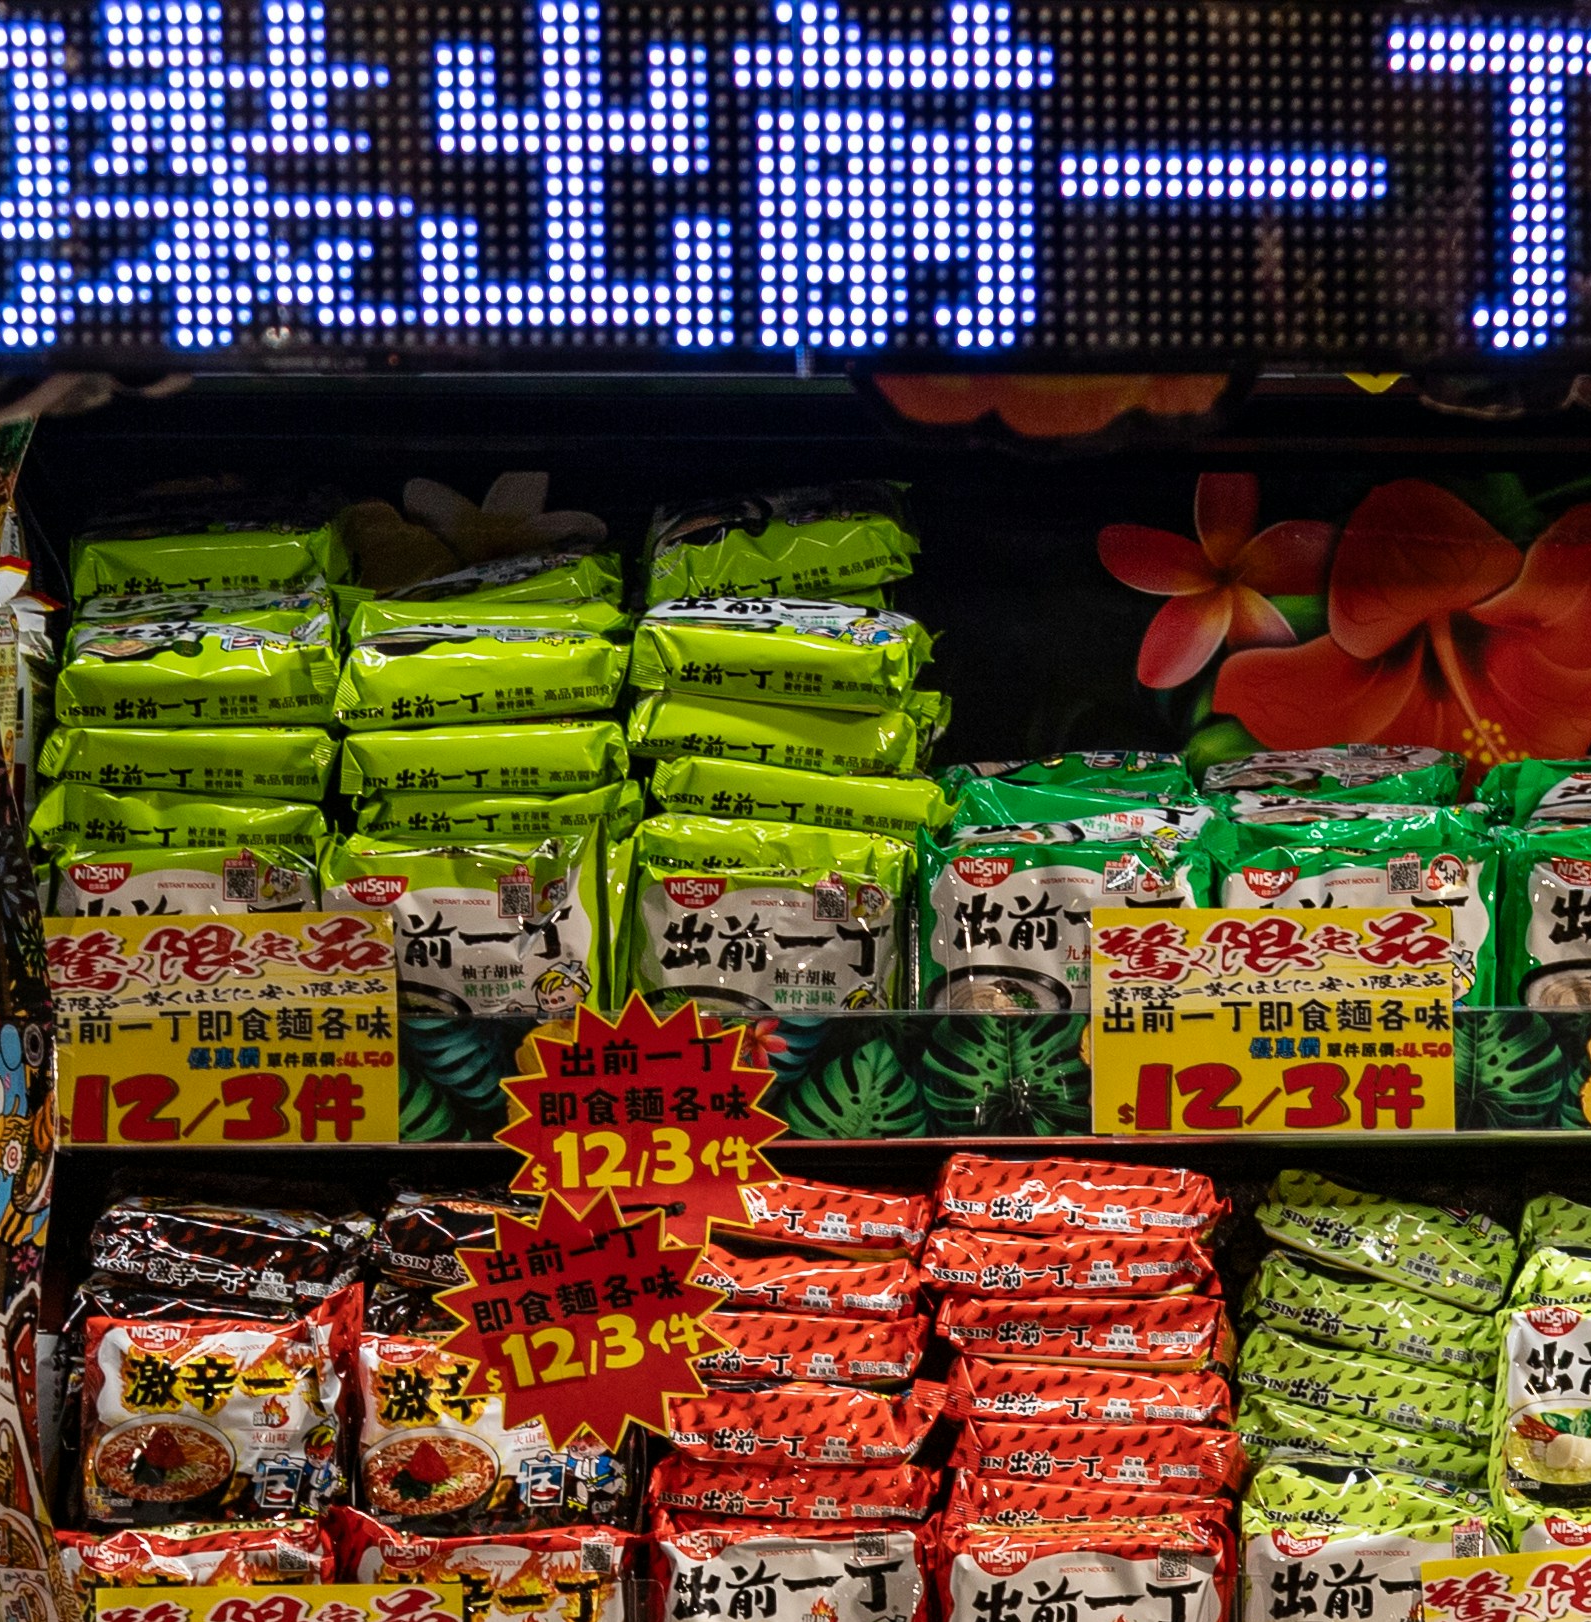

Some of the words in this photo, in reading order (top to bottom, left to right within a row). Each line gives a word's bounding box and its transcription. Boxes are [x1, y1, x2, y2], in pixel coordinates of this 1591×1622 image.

[75, 867, 125, 883] NISSIN
[958, 860, 1010, 876] NISSIN
[670, 882, 721, 897] NISSIN
[661, 915, 886, 976] 出前一丁
[1103, 1001, 1450, 1032] 出前一丁即食麵各味
[559, 1037, 723, 1078] 出前一丁
[540, 1084, 751, 1128] 即食麵各味
[485, 1224, 644, 1287] 出前一丁
[473, 1264, 683, 1335] 即食麵各味
[978, 1549, 1029, 1565] NISSIN
[672, 1560, 904, 1620] 出前一丁
